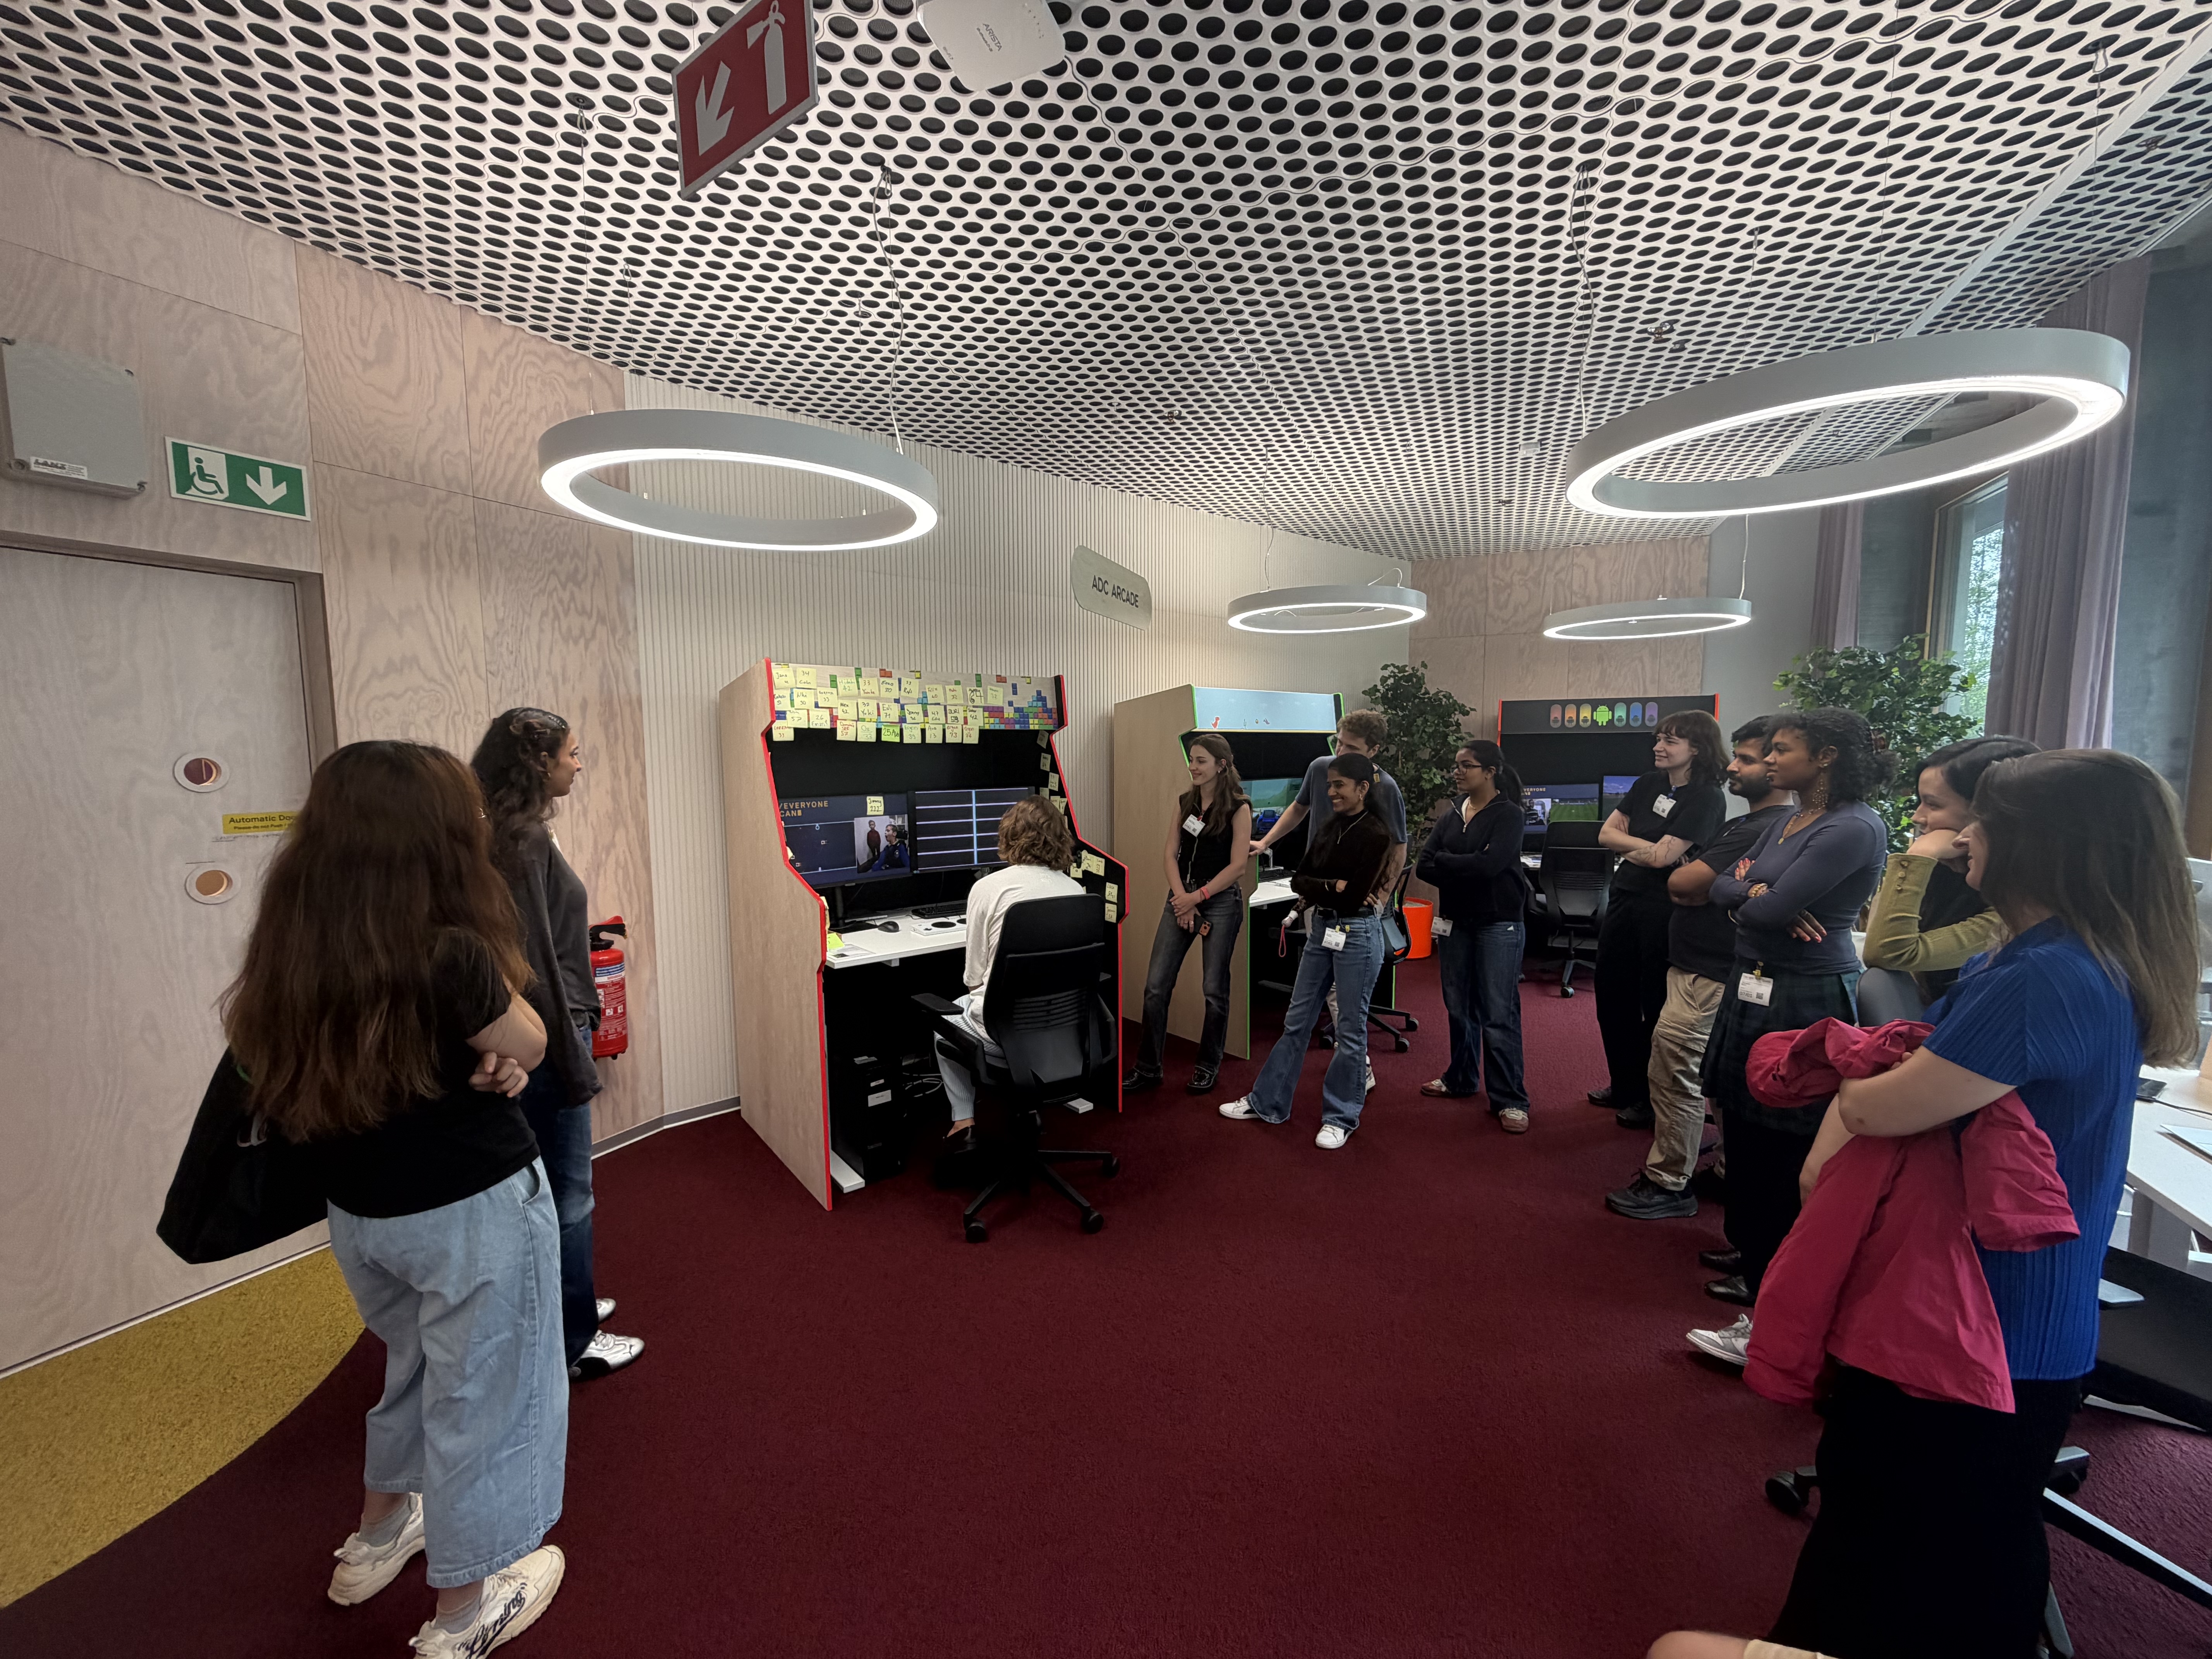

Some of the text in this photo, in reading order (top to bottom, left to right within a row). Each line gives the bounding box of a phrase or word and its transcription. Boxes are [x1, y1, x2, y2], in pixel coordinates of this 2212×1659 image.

[983, 23, 1002, 52] ARISTA
[1092, 575, 1139, 608] ADC ARCADE
[883, 728, 891, 736] 25
[228, 816, 276, 824] Automatic
